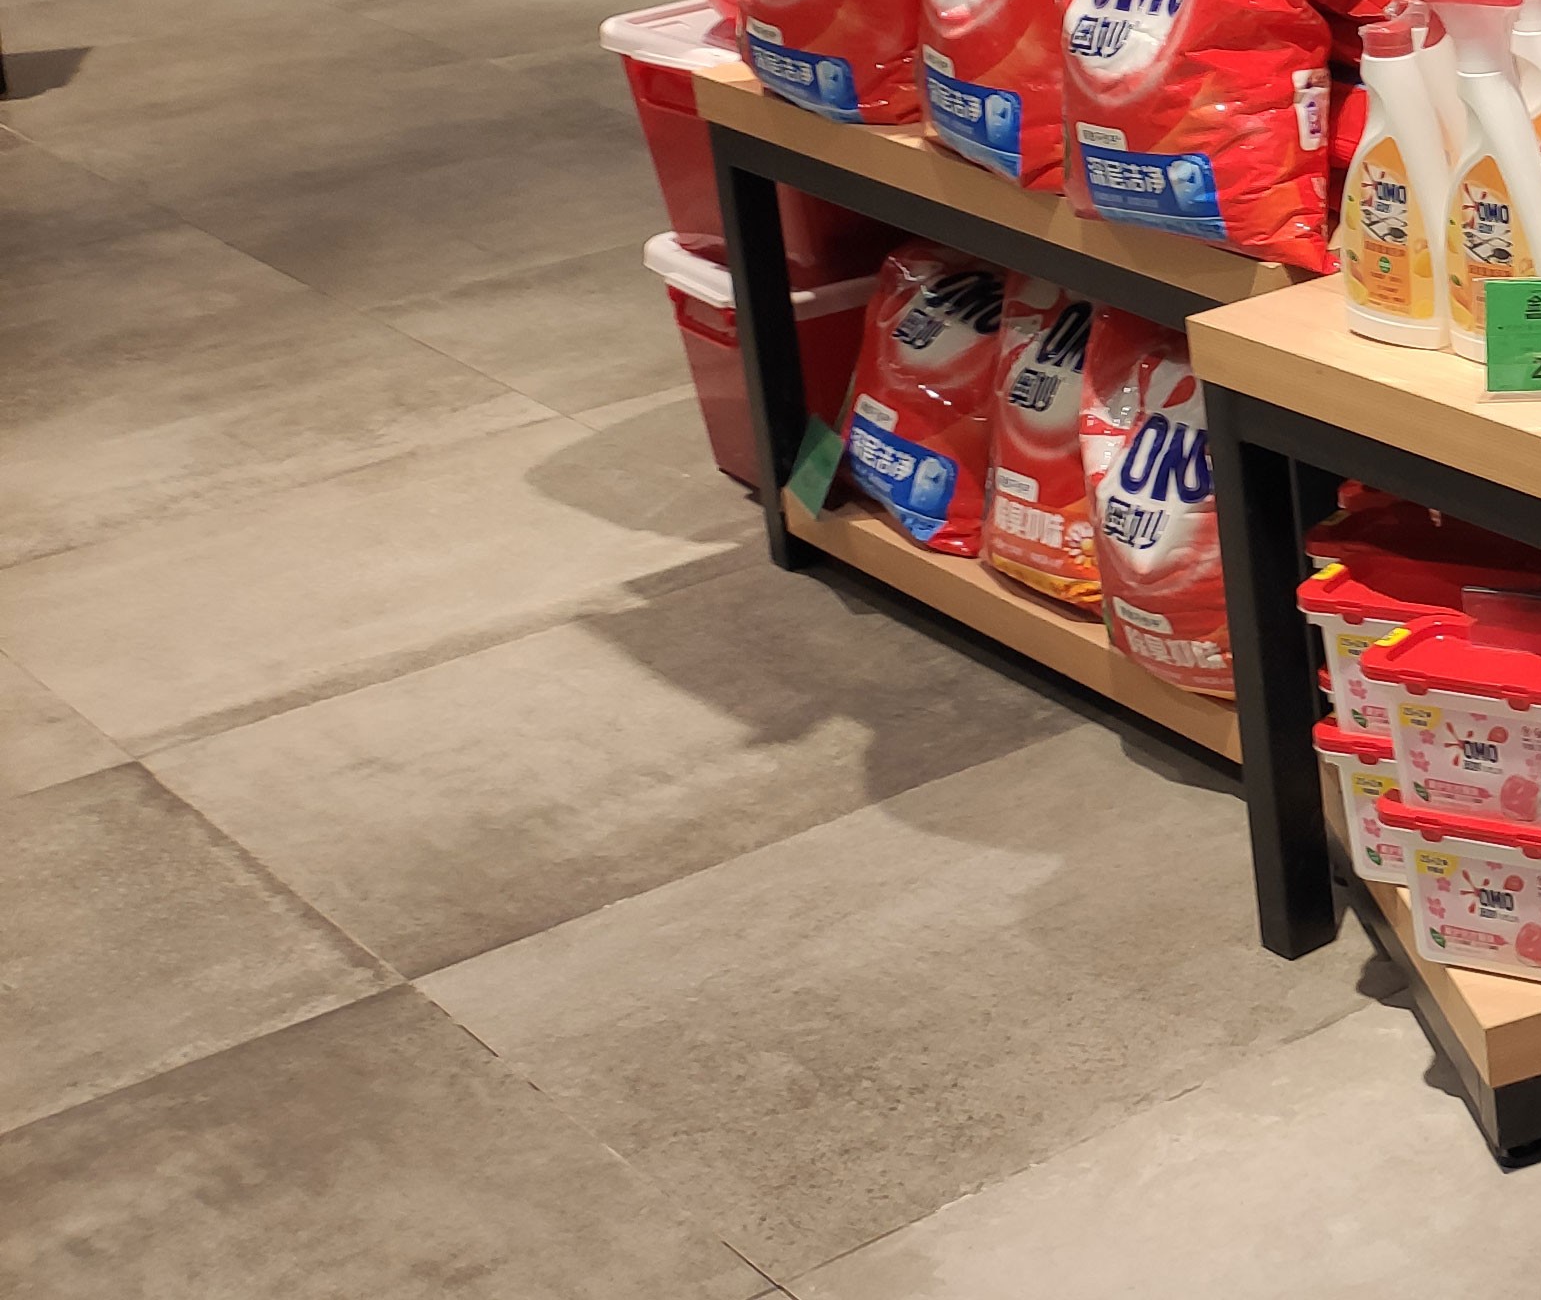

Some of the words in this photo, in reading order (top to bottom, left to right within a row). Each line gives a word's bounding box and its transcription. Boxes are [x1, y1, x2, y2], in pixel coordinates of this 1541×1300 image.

[1068, 13, 1135, 59] 奥妙
[1374, 180, 1408, 206] OMO
[1476, 200, 1510, 225] OMO
[1036, 301, 1092, 375] OM
[1463, 739, 1499, 765] OMO
[1479, 887, 1514, 912] OMO
